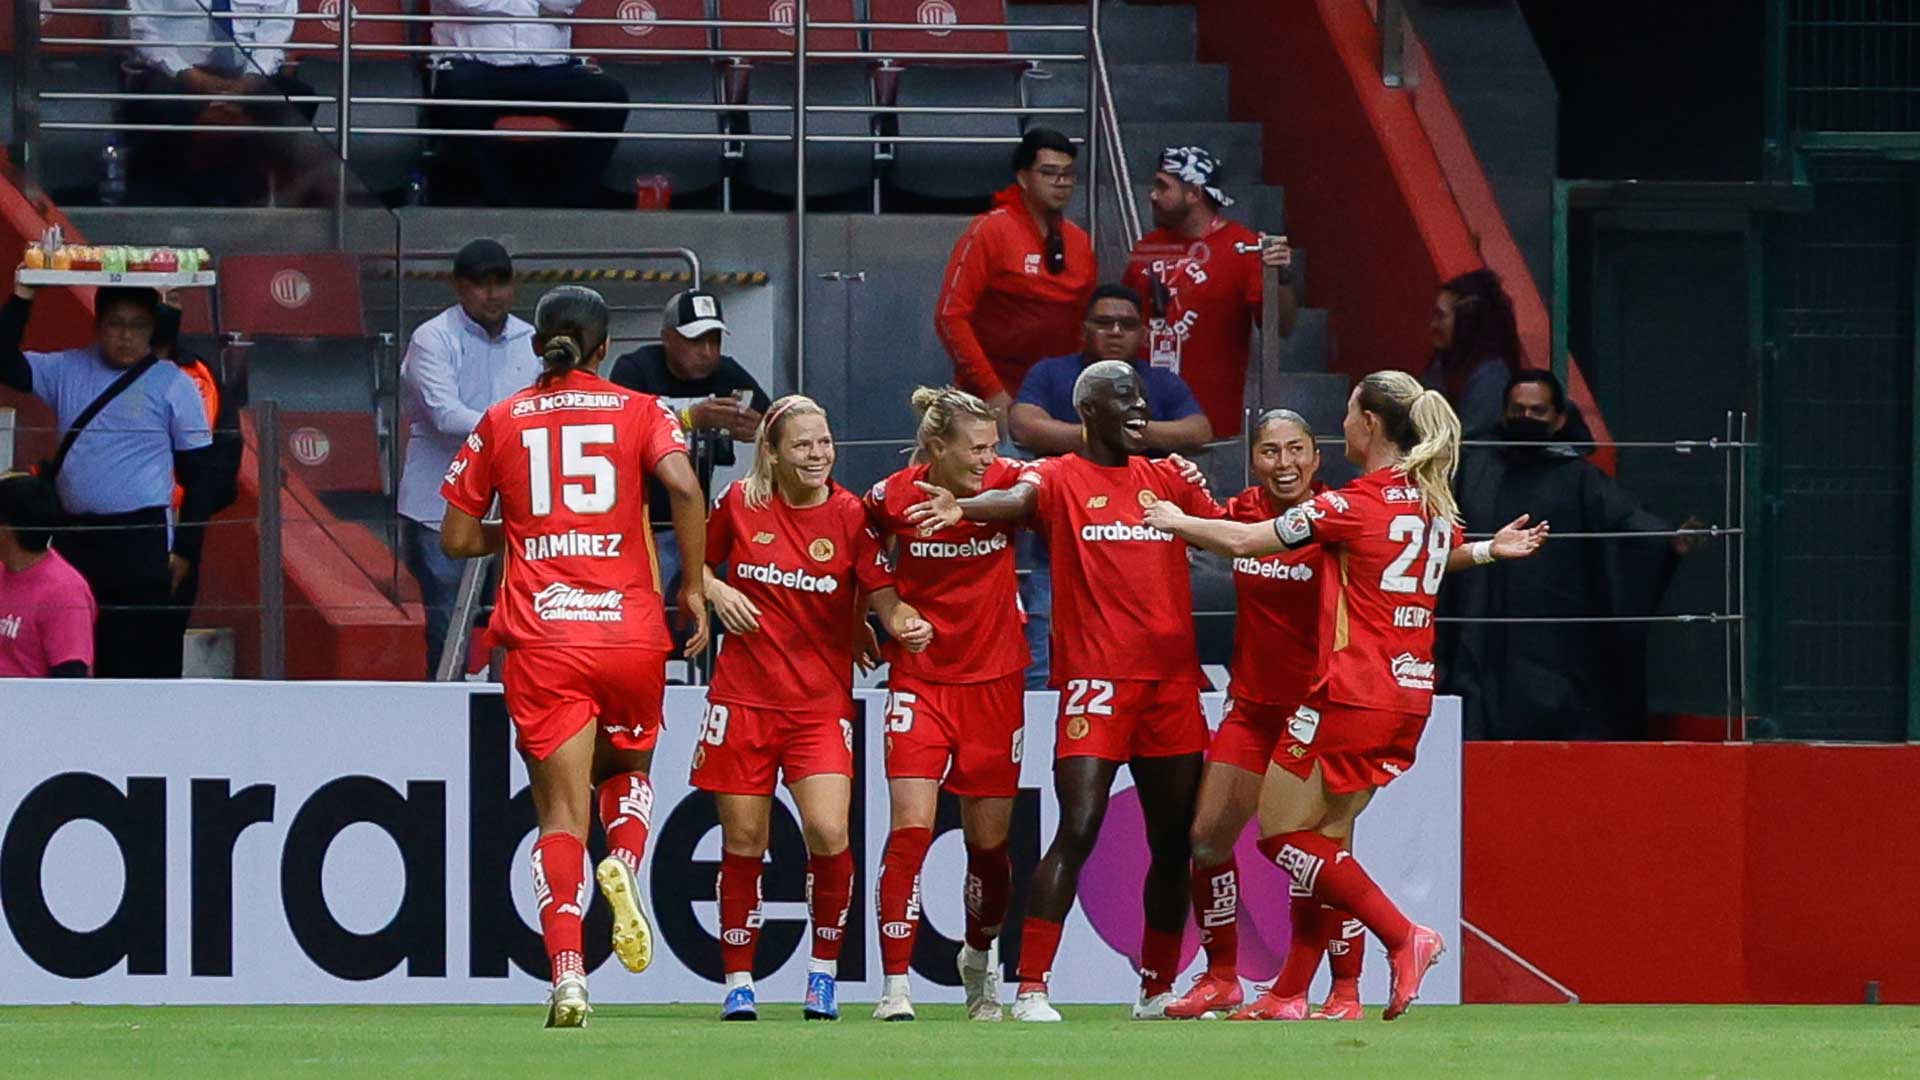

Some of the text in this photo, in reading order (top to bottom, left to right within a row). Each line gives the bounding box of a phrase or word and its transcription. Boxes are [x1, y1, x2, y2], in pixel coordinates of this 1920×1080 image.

[521, 423, 617, 517] 15
[524, 529, 623, 561] RAMÍREZ
[1081, 520, 1160, 541] arabela
[909, 537, 992, 558] arabela
[1379, 514, 1453, 596] 28
[737, 562, 818, 593] arabela
[1232, 556, 1291, 580] rabela
[1065, 679, 1115, 716] 22
